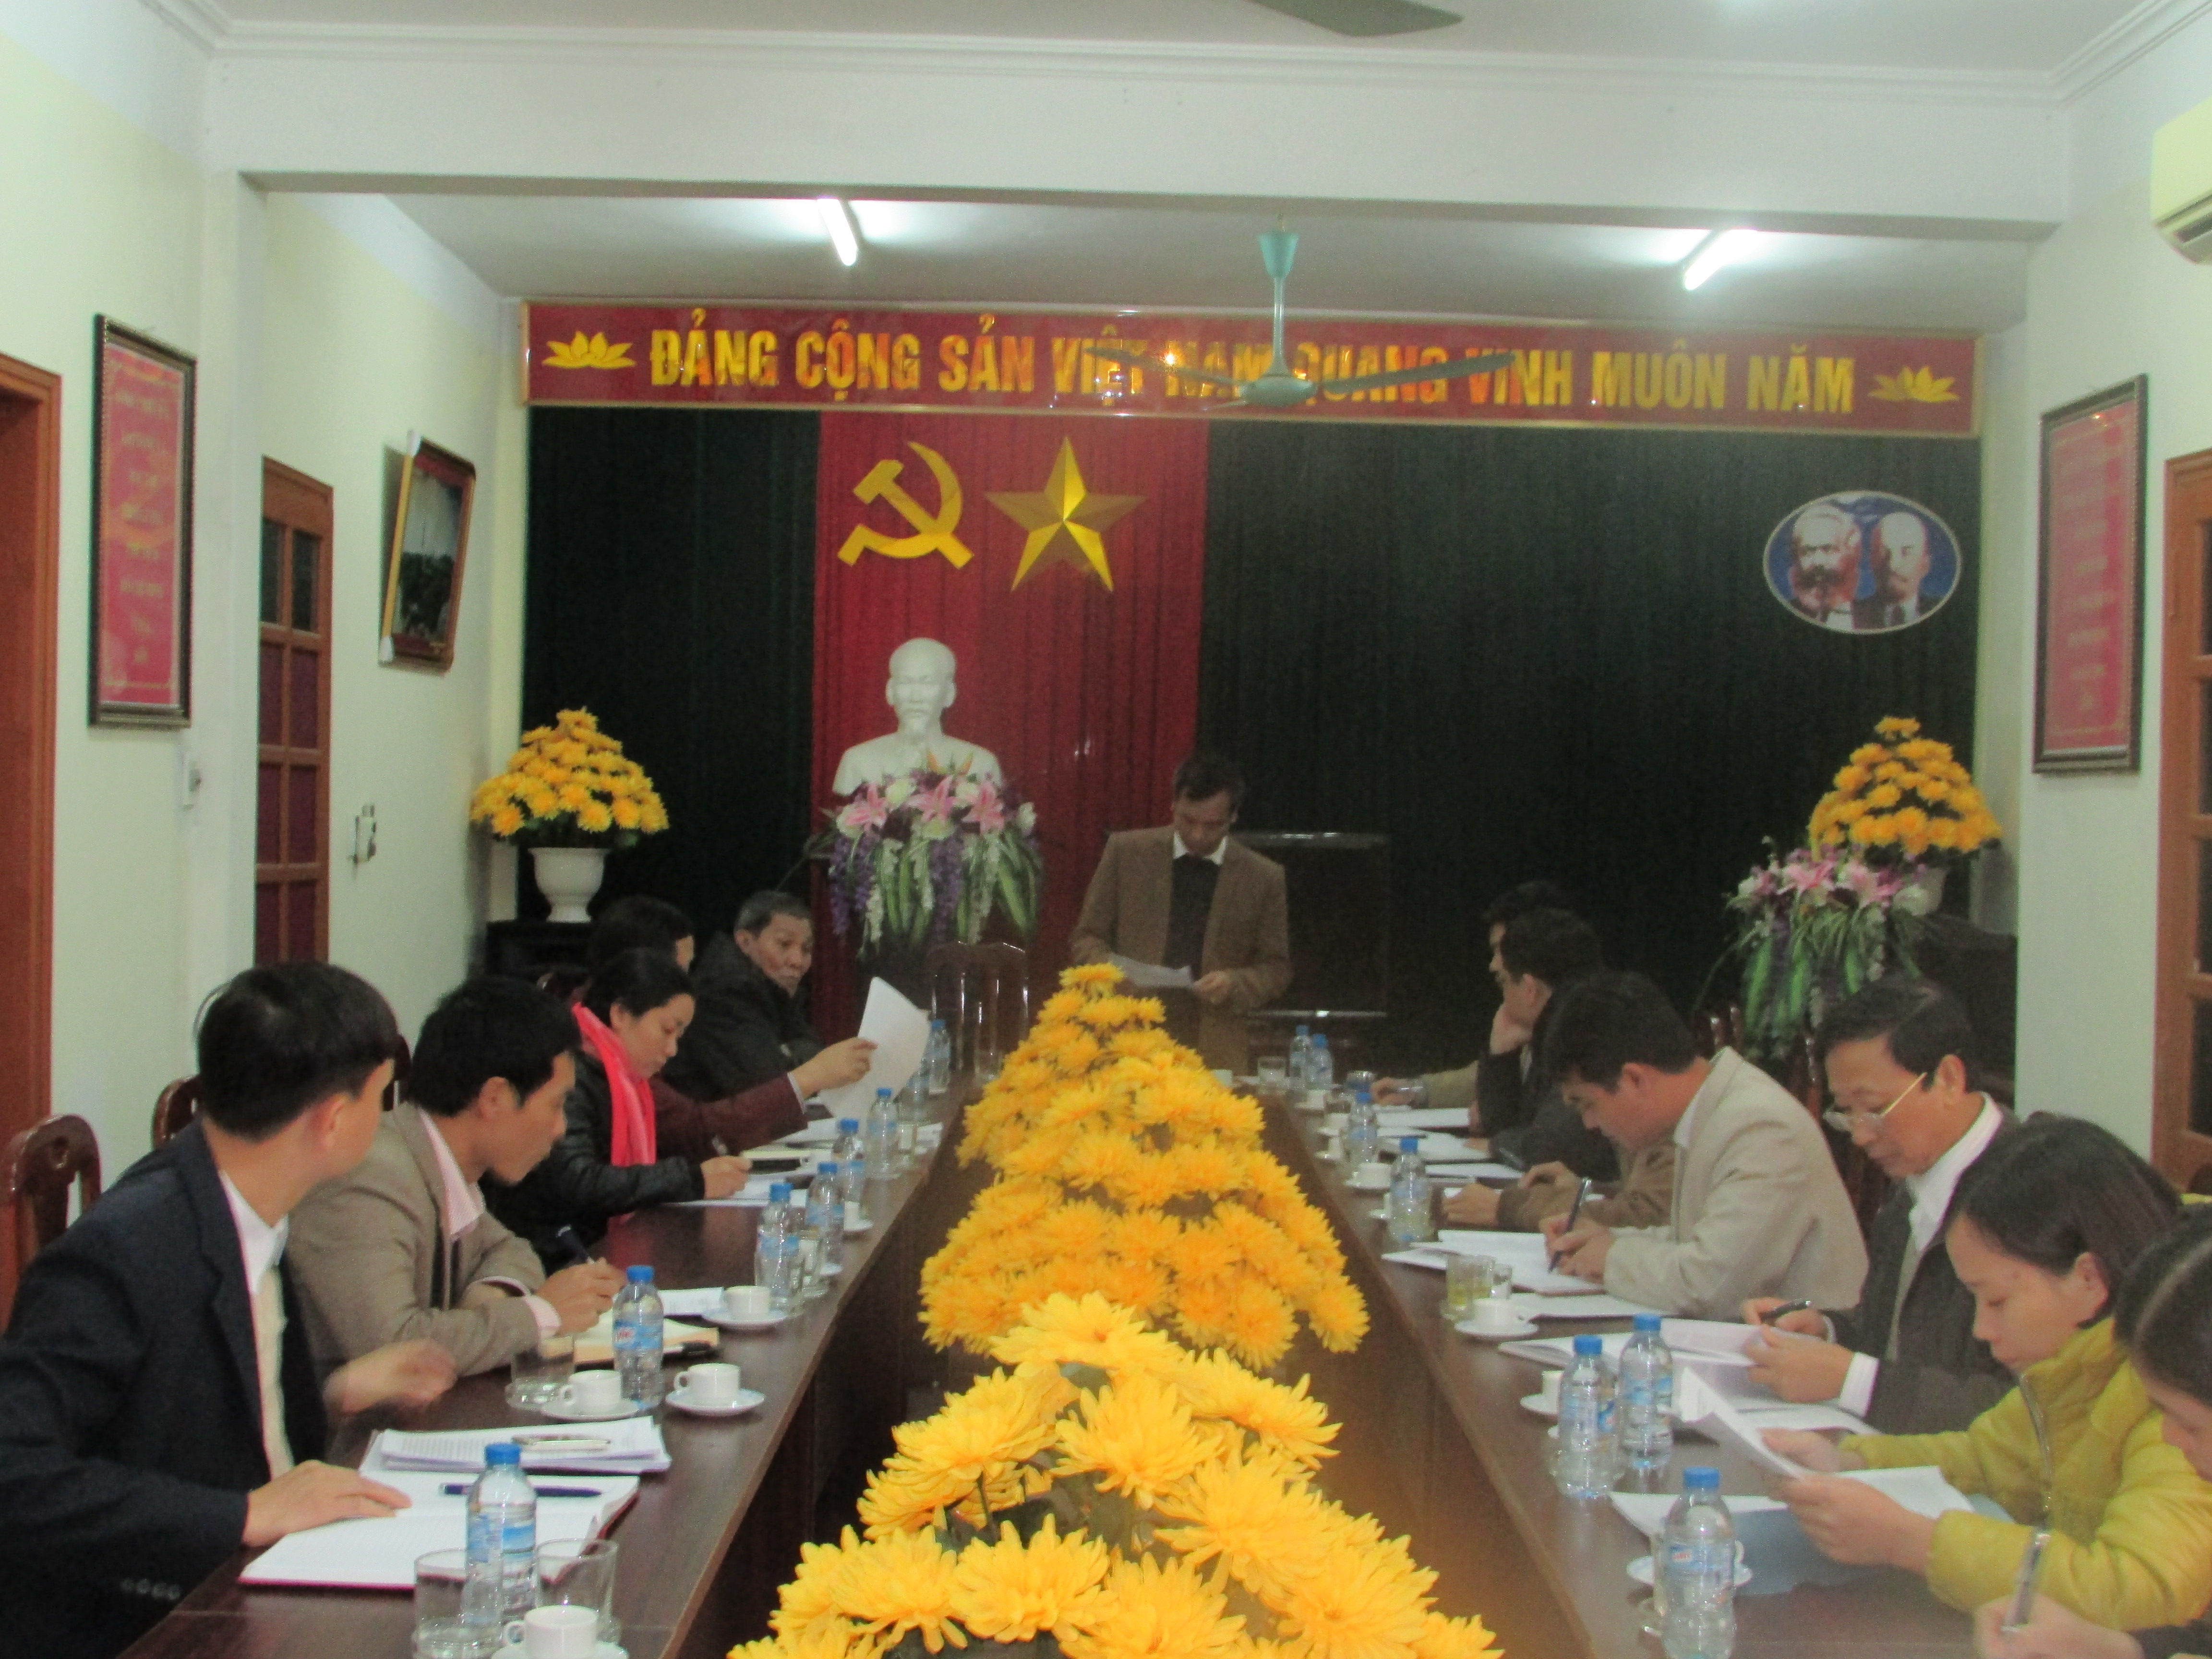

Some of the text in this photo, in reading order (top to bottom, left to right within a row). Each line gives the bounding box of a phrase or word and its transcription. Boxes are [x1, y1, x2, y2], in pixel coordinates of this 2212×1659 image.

[650, 307, 779, 387] ĐẢNG
[795, 318, 921, 402] CỘNG
[937, 313, 1035, 393] SẢN
[1465, 347, 1573, 407] VINH
[1592, 339, 1728, 409] MUÔN
[1745, 343, 1855, 413] NĂM
